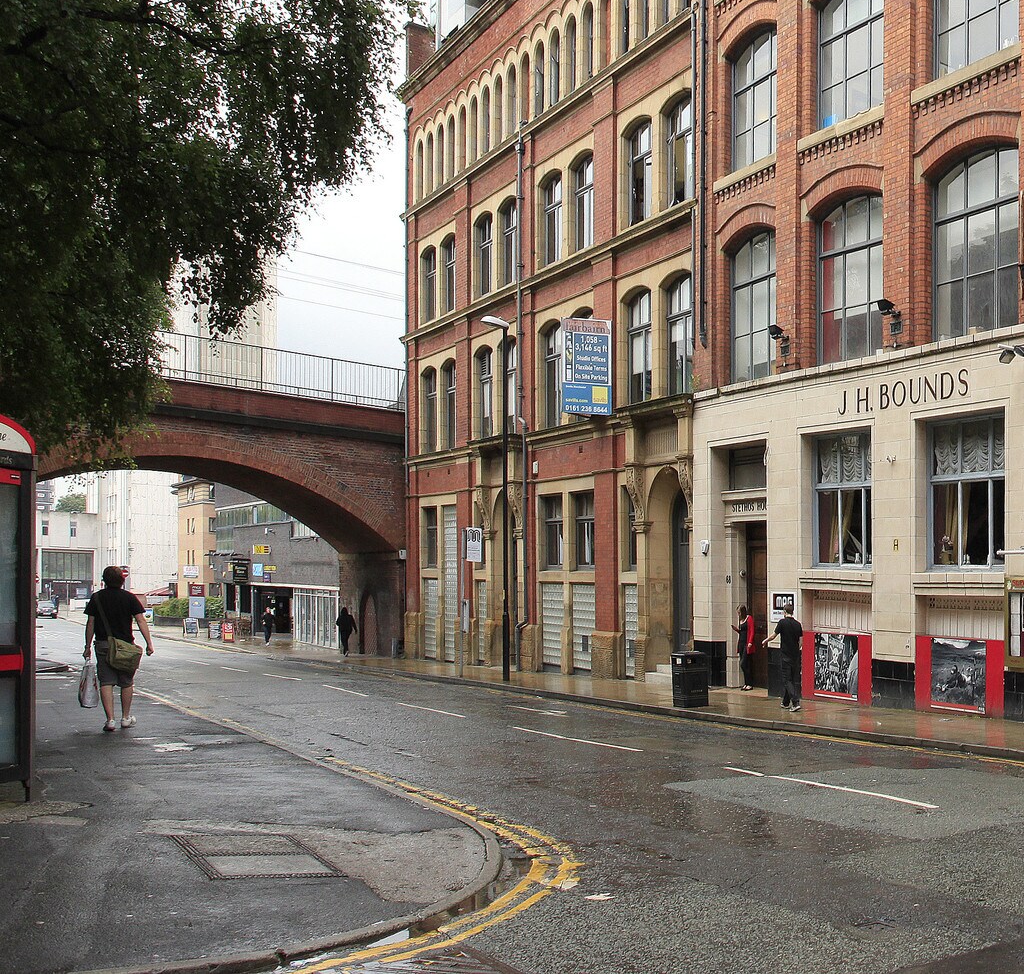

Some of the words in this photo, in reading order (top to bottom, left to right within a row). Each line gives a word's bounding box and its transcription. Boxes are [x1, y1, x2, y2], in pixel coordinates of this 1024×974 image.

[593, 346, 601, 354] sq
[602, 345, 608, 353] ft
[591, 374, 608, 382] Parking
[880, 369, 969, 410] BOUNDS
